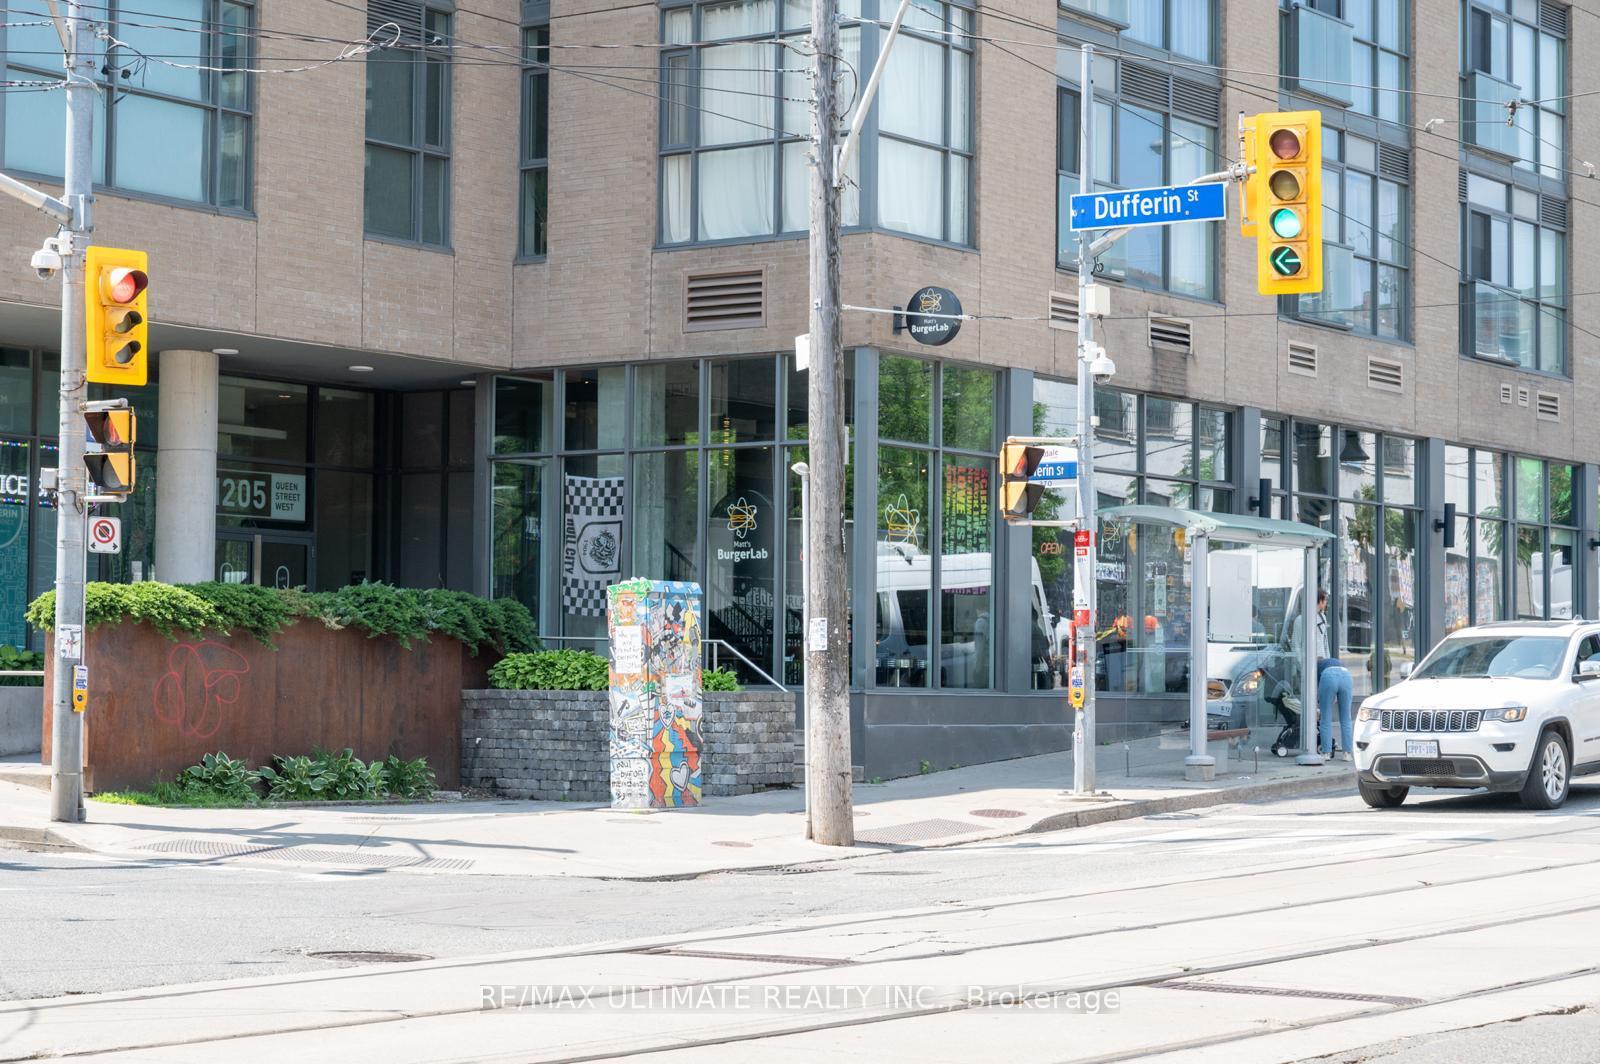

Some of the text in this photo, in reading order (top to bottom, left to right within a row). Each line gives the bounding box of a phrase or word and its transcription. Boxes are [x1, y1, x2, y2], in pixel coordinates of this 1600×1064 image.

[1094, 190, 1199, 219] Dufferin St
[911, 323, 949, 334] BurgerLab
[1044, 449, 1058, 457] dale
[1056, 466, 1064, 476] St
[275, 481, 298, 491] QUEEN
[957, 466, 966, 514] LOVE
[275, 492, 301, 502] STREET
[275, 502, 295, 512] WEST
[957, 518, 966, 541] IS
[564, 518, 577, 574] HULL CITY
[1040, 542, 1064, 554] OPEN
[717, 548, 768, 562] BurgerLab
